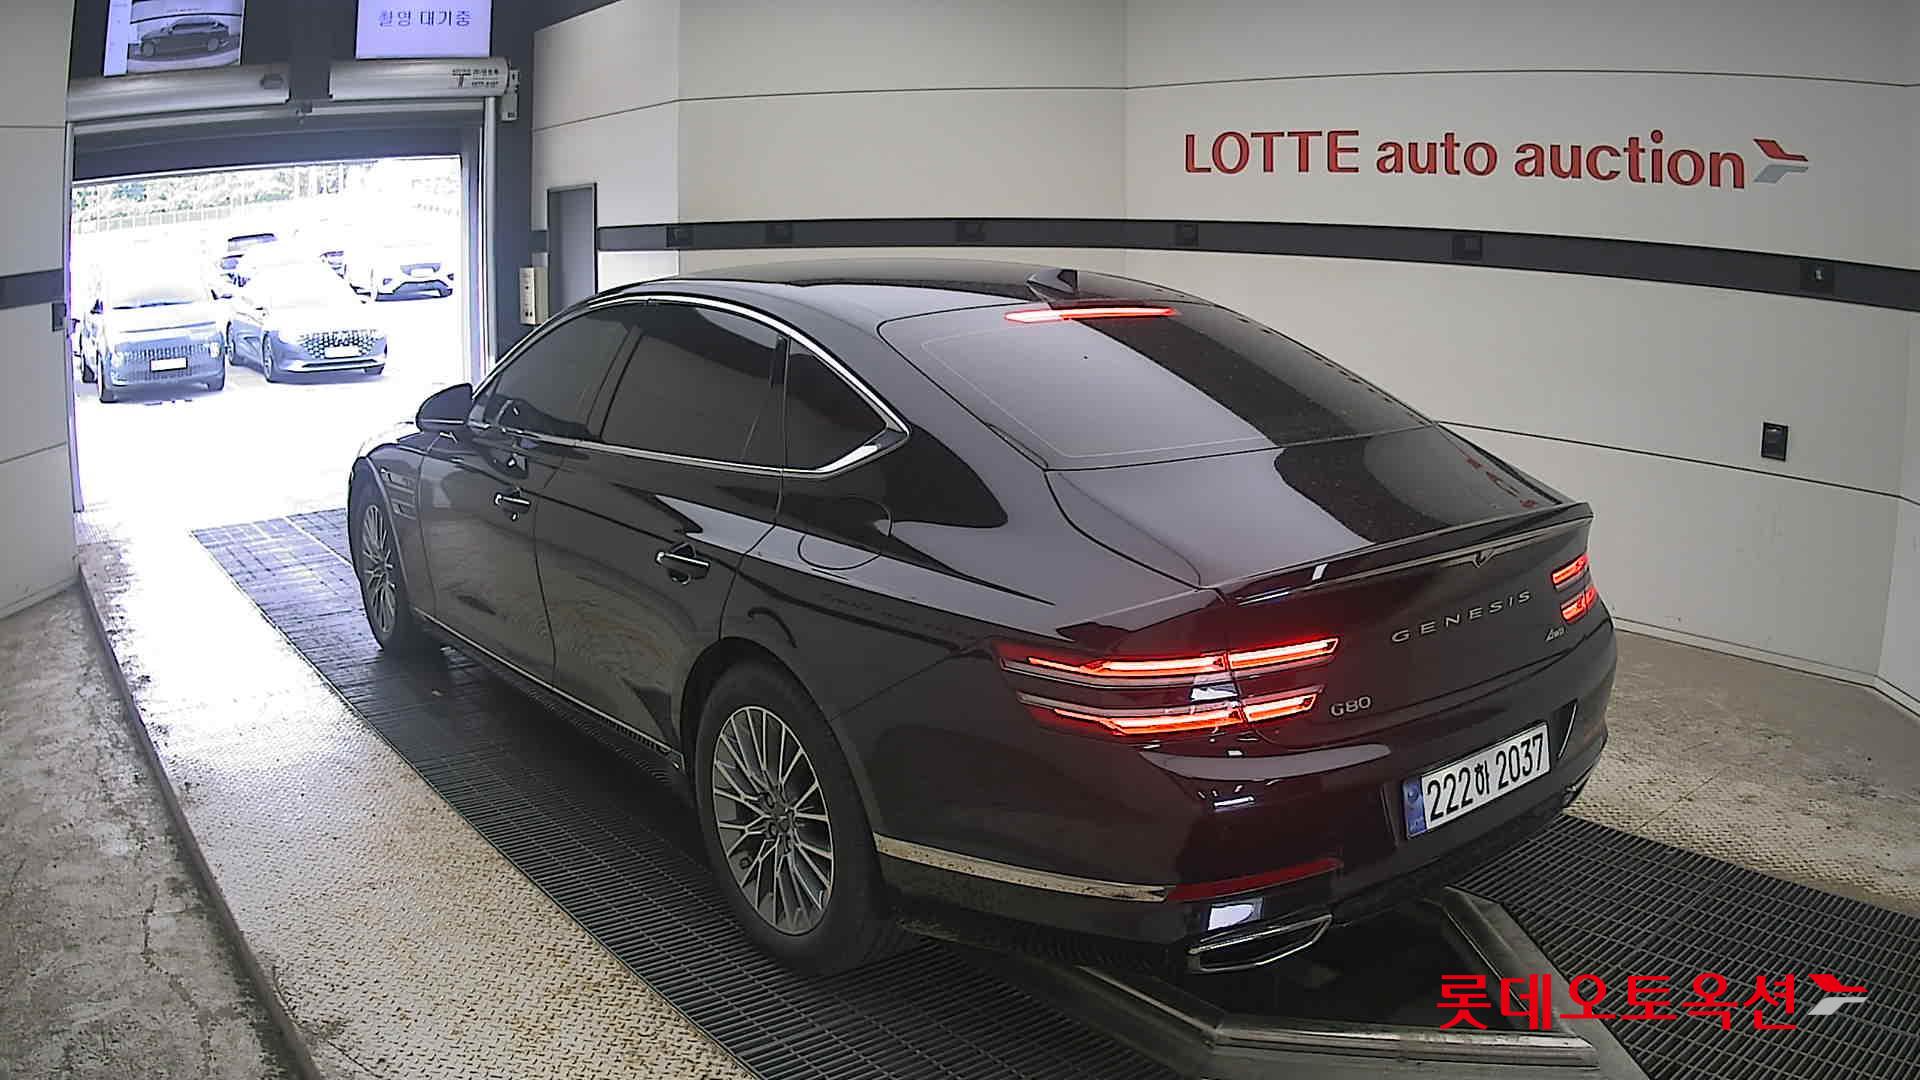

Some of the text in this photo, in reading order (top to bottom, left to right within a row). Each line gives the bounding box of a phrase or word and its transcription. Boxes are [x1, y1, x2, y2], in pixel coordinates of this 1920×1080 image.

[420, 10, 471, 27] 대기중
[1185, 129, 1745, 189] LOTTE auto auction
[1391, 590, 1531, 643] GENESIS
[1330, 696, 1372, 717] G80
[1426, 732, 1544, 822] 222하 2037
